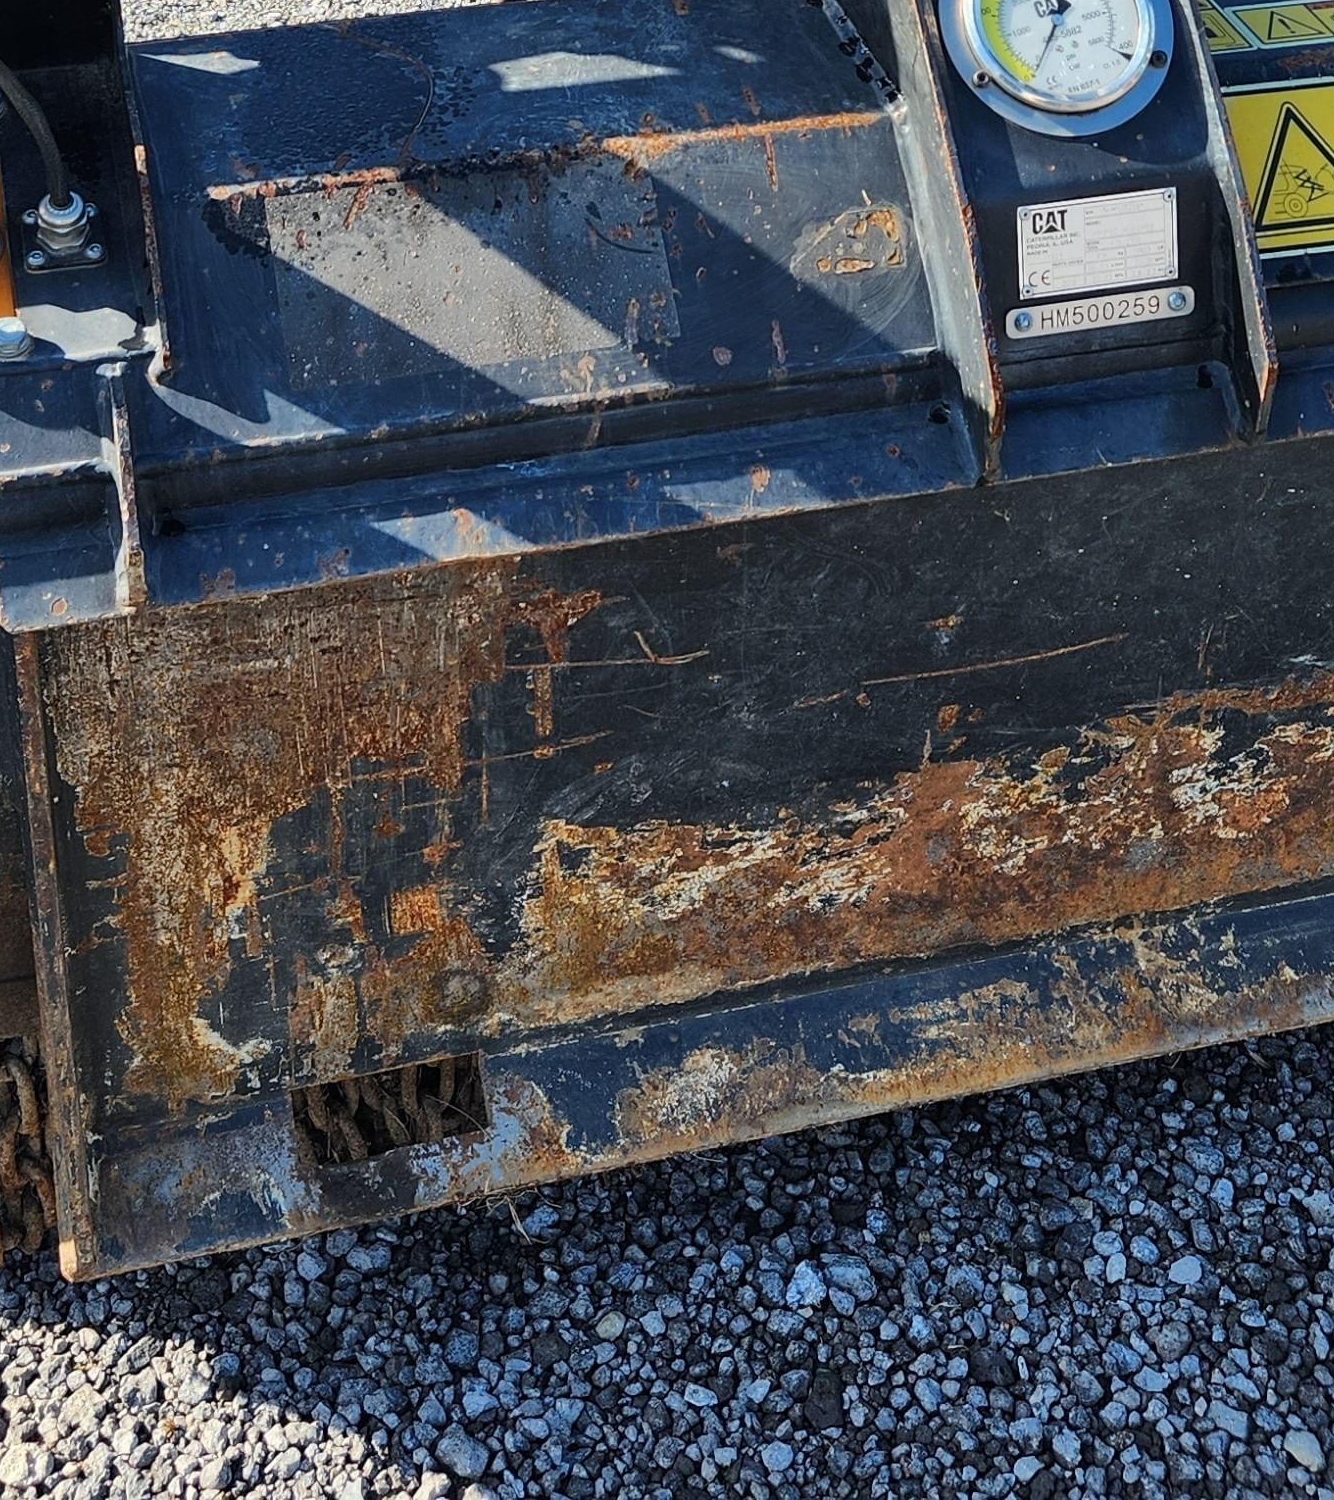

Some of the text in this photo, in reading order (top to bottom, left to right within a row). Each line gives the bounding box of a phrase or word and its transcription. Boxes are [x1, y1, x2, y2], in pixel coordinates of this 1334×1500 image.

[1081, 10, 1101, 21] 5000
[1118, 40, 1134, 51] 400
[1032, 209, 1068, 235] CAT
[1040, 295, 1161, 330] HM500259
